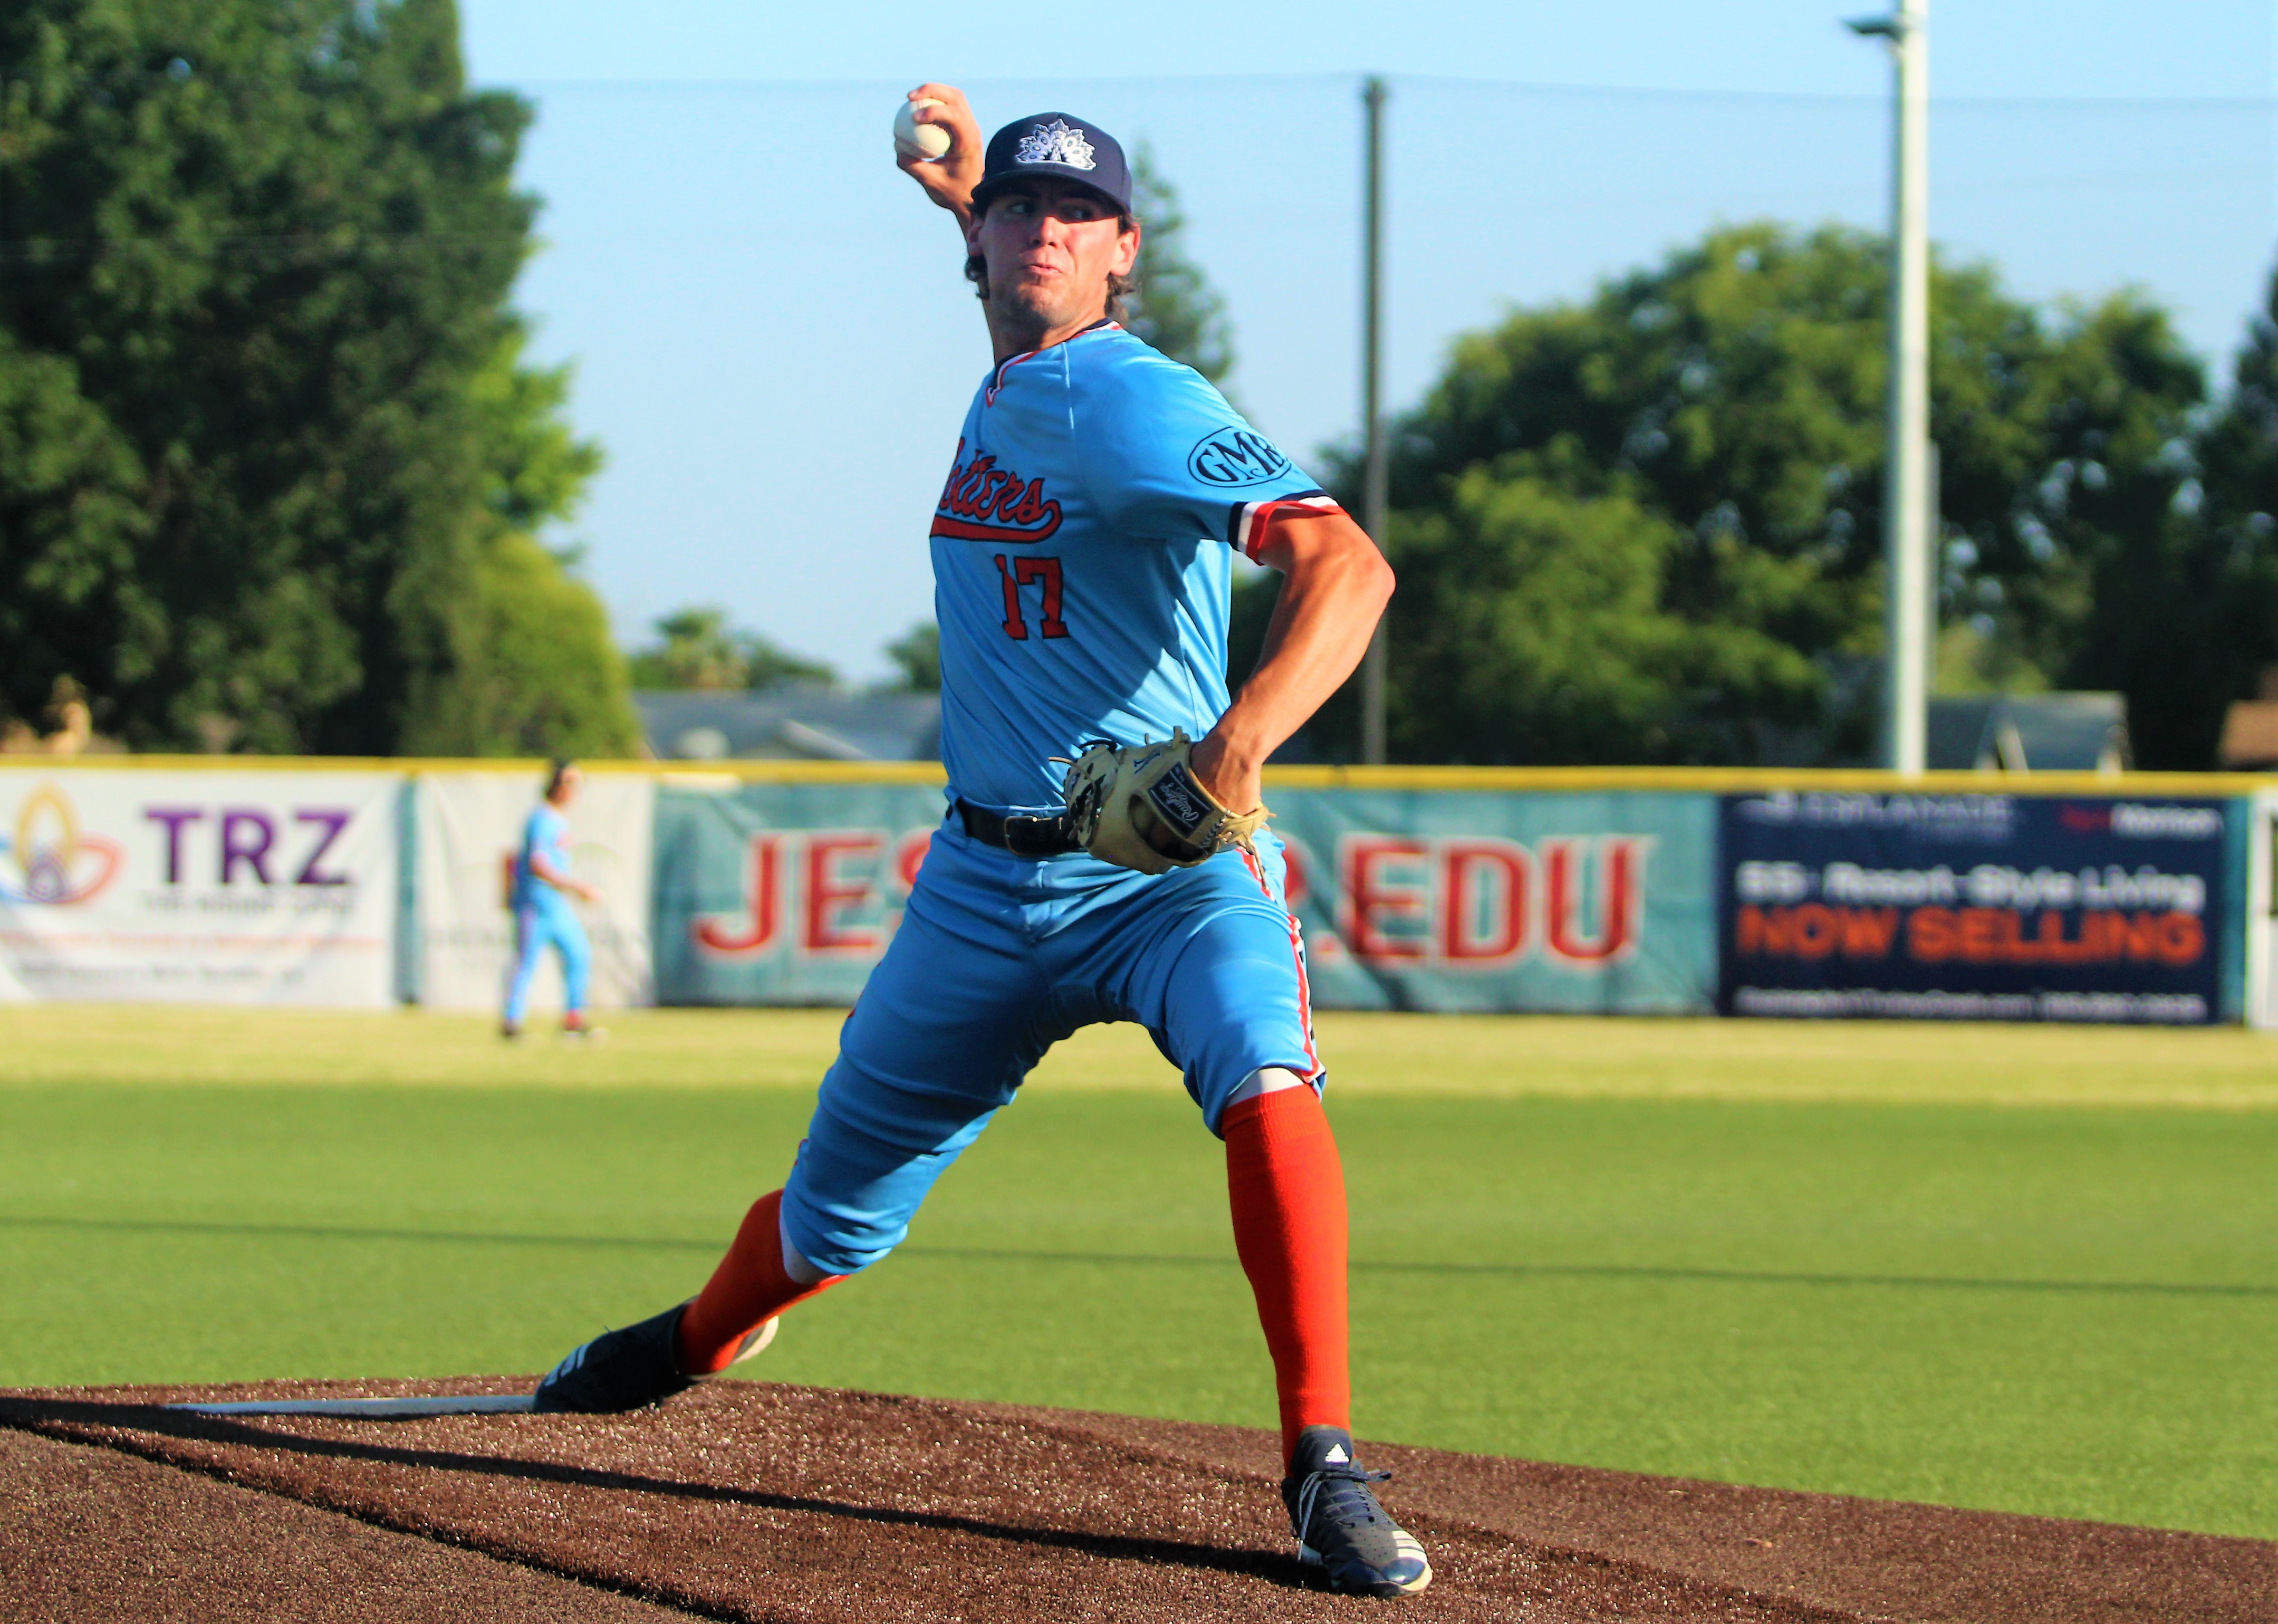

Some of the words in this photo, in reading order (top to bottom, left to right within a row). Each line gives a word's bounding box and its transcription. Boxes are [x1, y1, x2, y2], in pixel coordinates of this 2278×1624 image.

[938, 437, 1047, 525] otters
[994, 553, 1071, 640] 17
[142, 808, 354, 885] TRZ
[1738, 903, 1898, 957] NOW
[1908, 906, 2205, 964] SELLING
